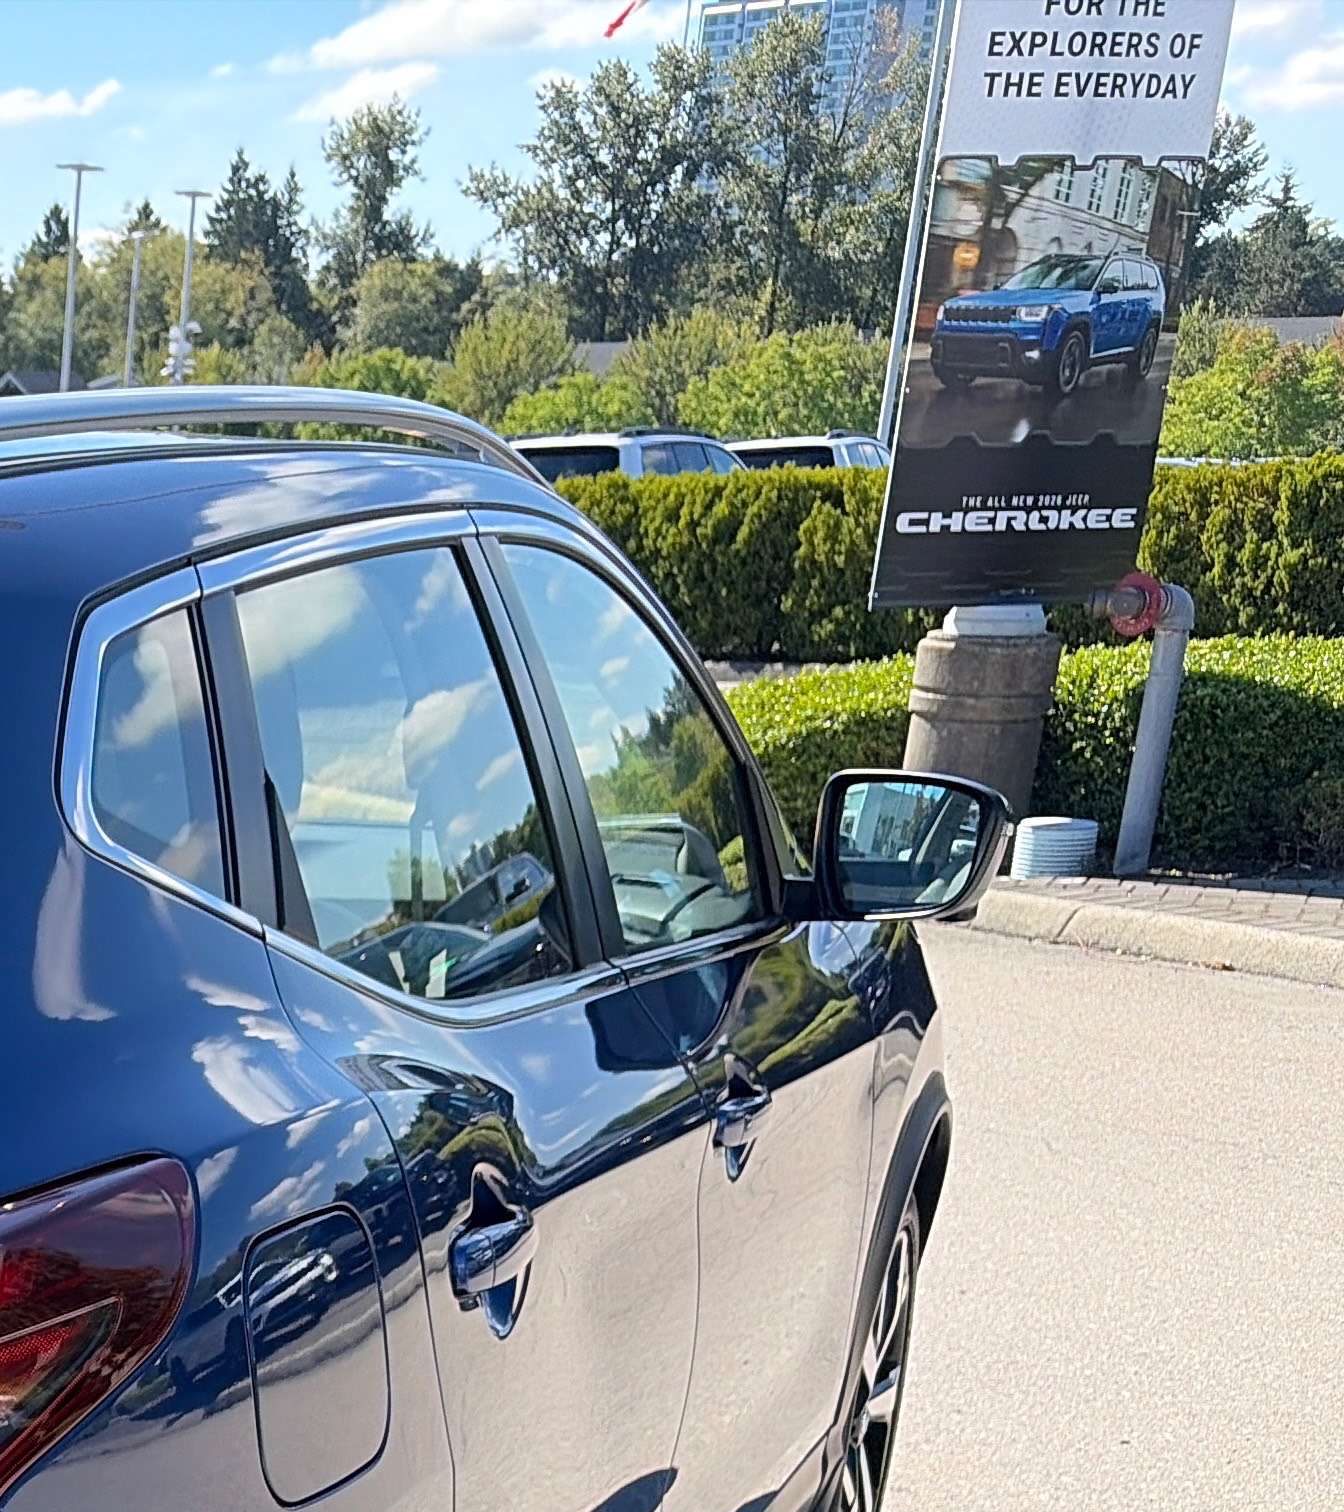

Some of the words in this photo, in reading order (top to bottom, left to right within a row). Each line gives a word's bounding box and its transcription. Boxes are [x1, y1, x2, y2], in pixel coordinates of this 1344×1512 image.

[1045, 0, 1103, 16] FOR
[1116, 0, 1166, 17] THE
[987, 31, 1160, 57] EXPLORERS
[1169, 33, 1203, 59] OF
[984, 72, 1045, 97] THE
[1054, 72, 1196, 99] EVERYDAY
[962, 496, 983, 508] THE
[987, 496, 1006, 507] ALL
[1012, 495, 1034, 507] NEW
[1065, 494, 1090, 506] JEEP
[896, 508, 1138, 534] CHEROKEE
